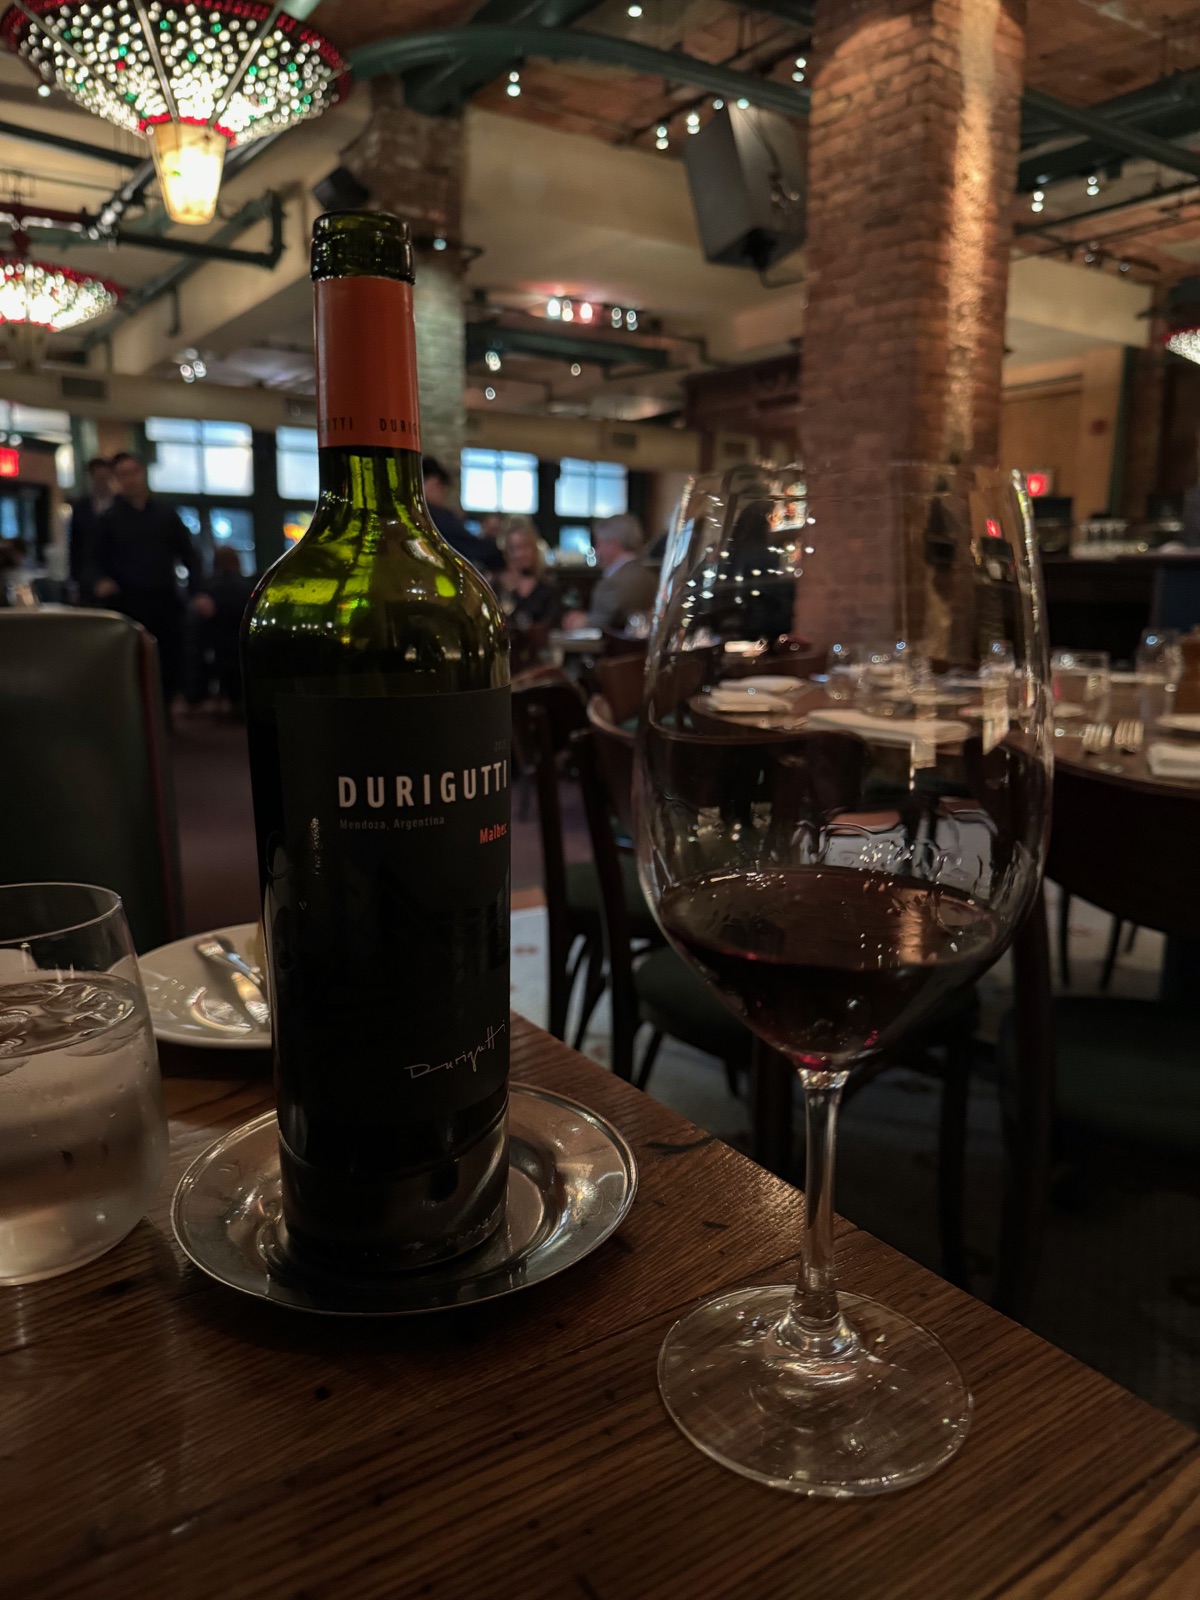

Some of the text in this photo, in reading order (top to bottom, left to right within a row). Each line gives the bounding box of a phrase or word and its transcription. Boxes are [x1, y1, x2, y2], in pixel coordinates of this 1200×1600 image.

[337, 759, 508, 808] DURIGUTTI
[339, 813, 446, 832] Mendoza, Argentina
[403, 1019, 506, 1080] Durigutti
